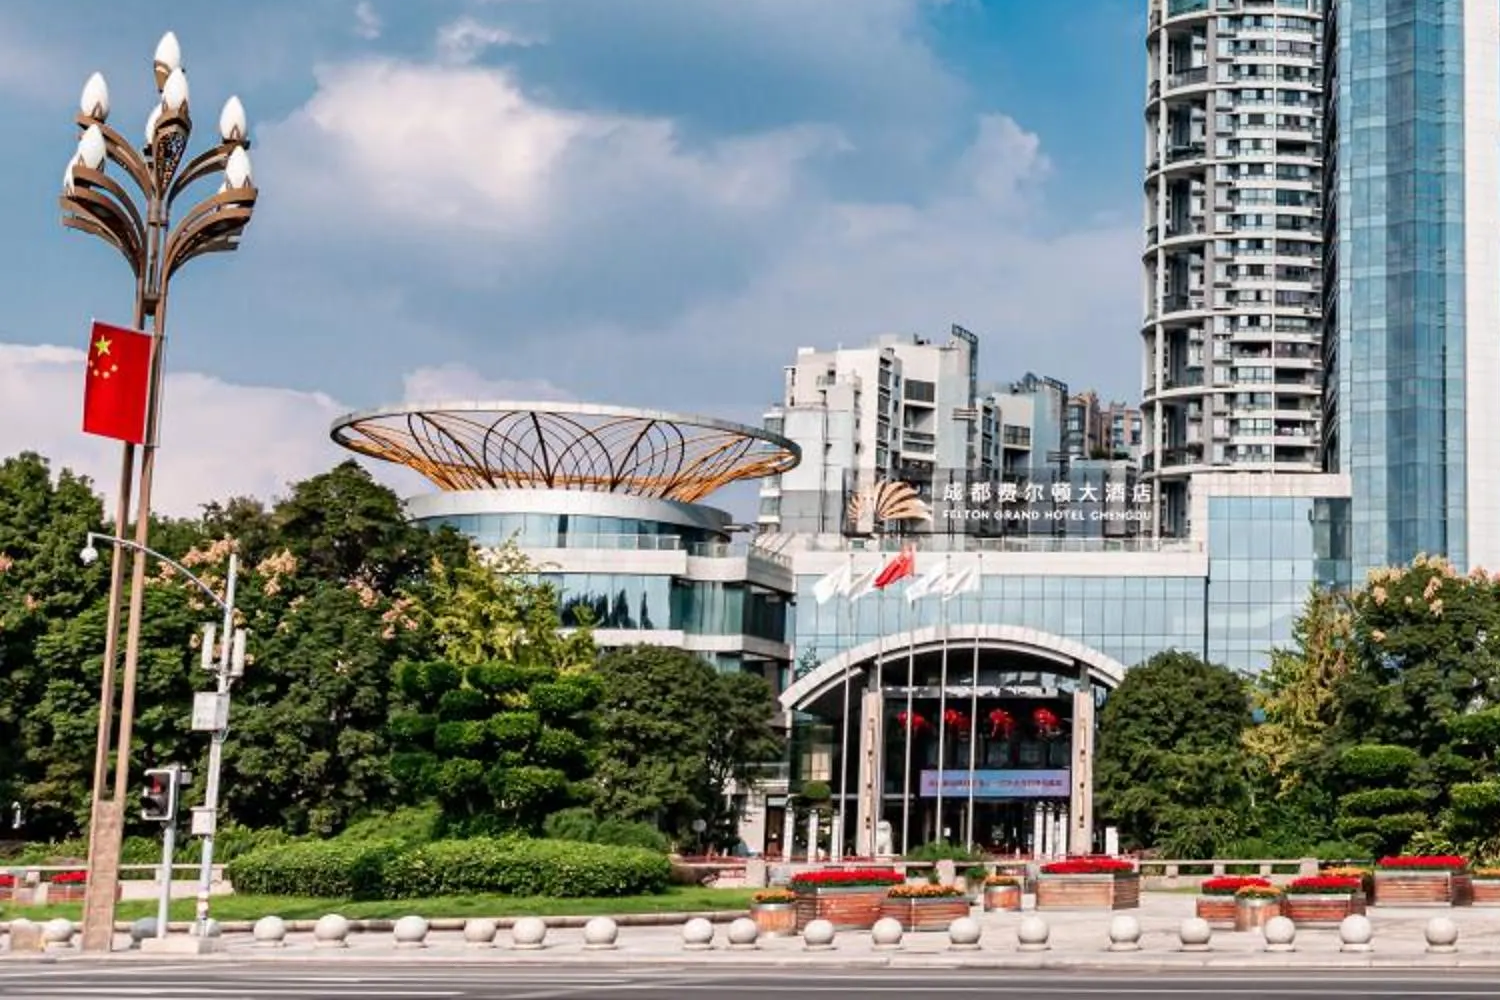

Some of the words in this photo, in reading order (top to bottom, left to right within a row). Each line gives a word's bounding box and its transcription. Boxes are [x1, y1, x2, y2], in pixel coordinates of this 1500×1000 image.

[943, 481, 1152, 503] 成都费尔顿大酒店
[943, 509, 989, 520] FELTON
[994, 509, 1039, 521] GRAND
[1044, 509, 1085, 521] HOTEL
[1091, 509, 1152, 521] CHENGDU
